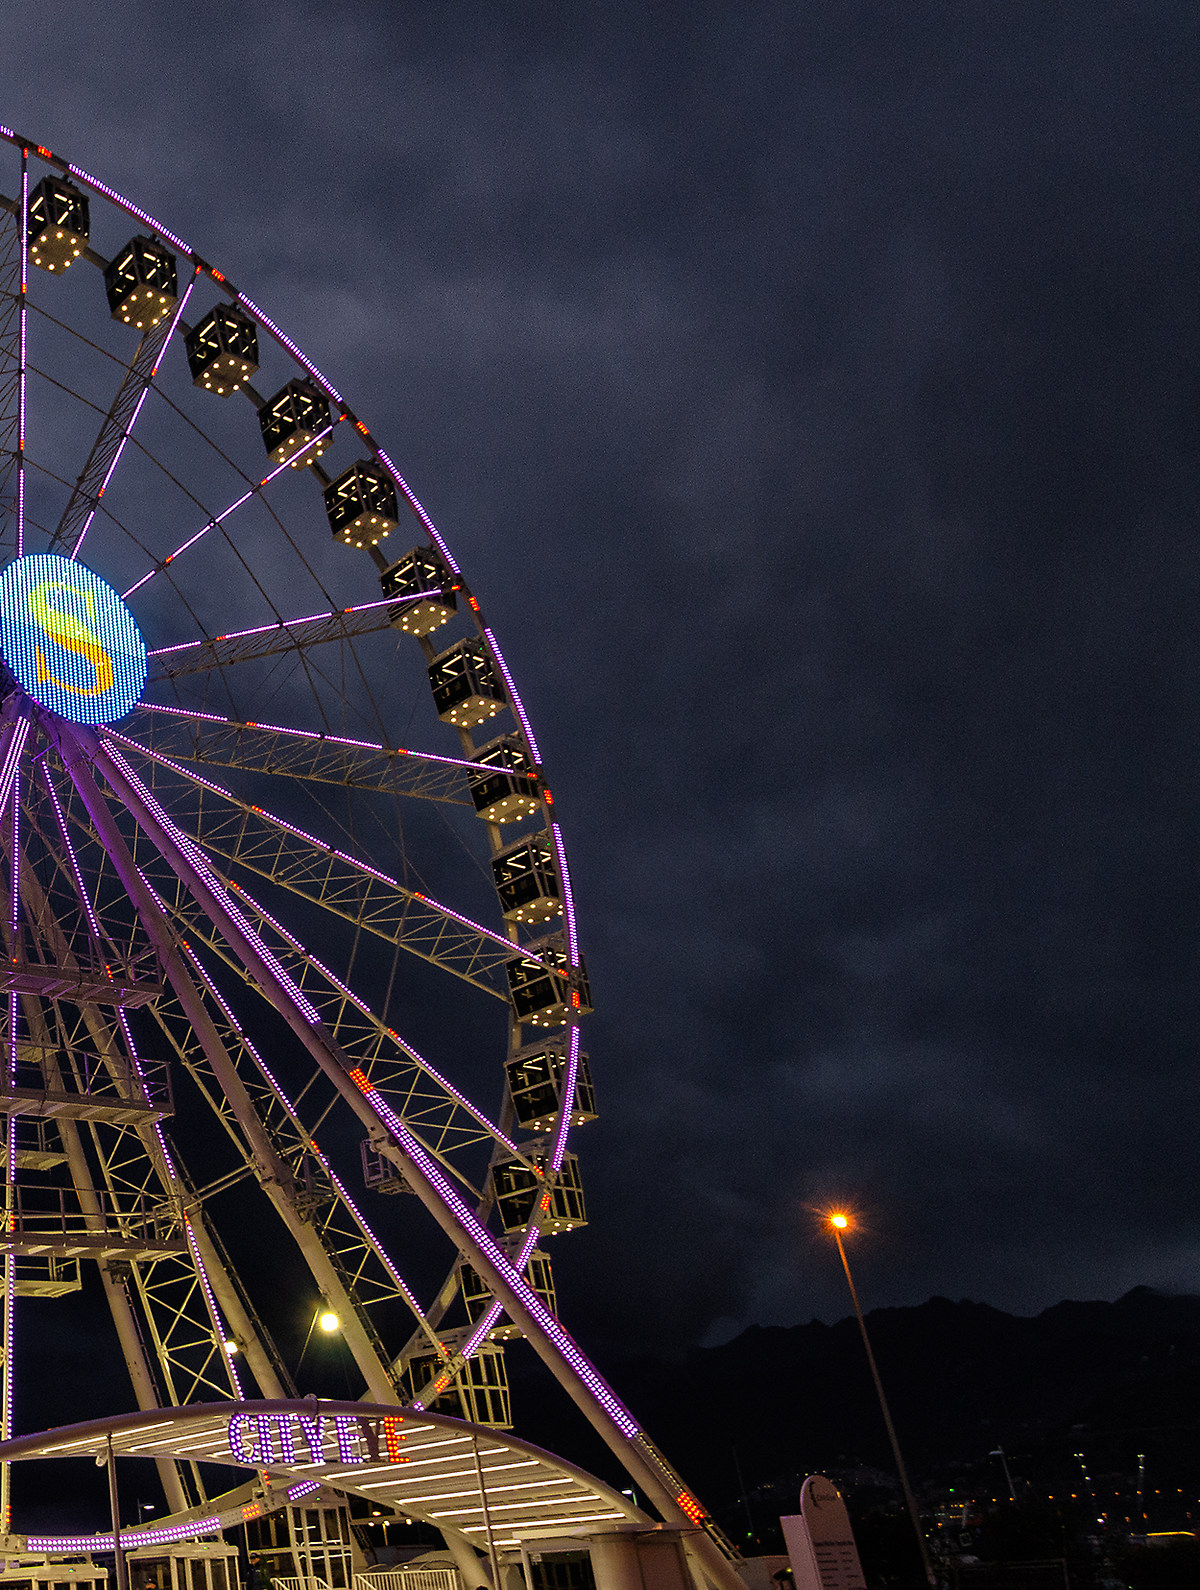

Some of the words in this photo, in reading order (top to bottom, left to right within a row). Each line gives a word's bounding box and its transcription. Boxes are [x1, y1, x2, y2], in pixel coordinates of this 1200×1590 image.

[28, 581, 114, 696] S
[228, 1413, 325, 1464] CITY
[335, 1415, 411, 1463] EYE
